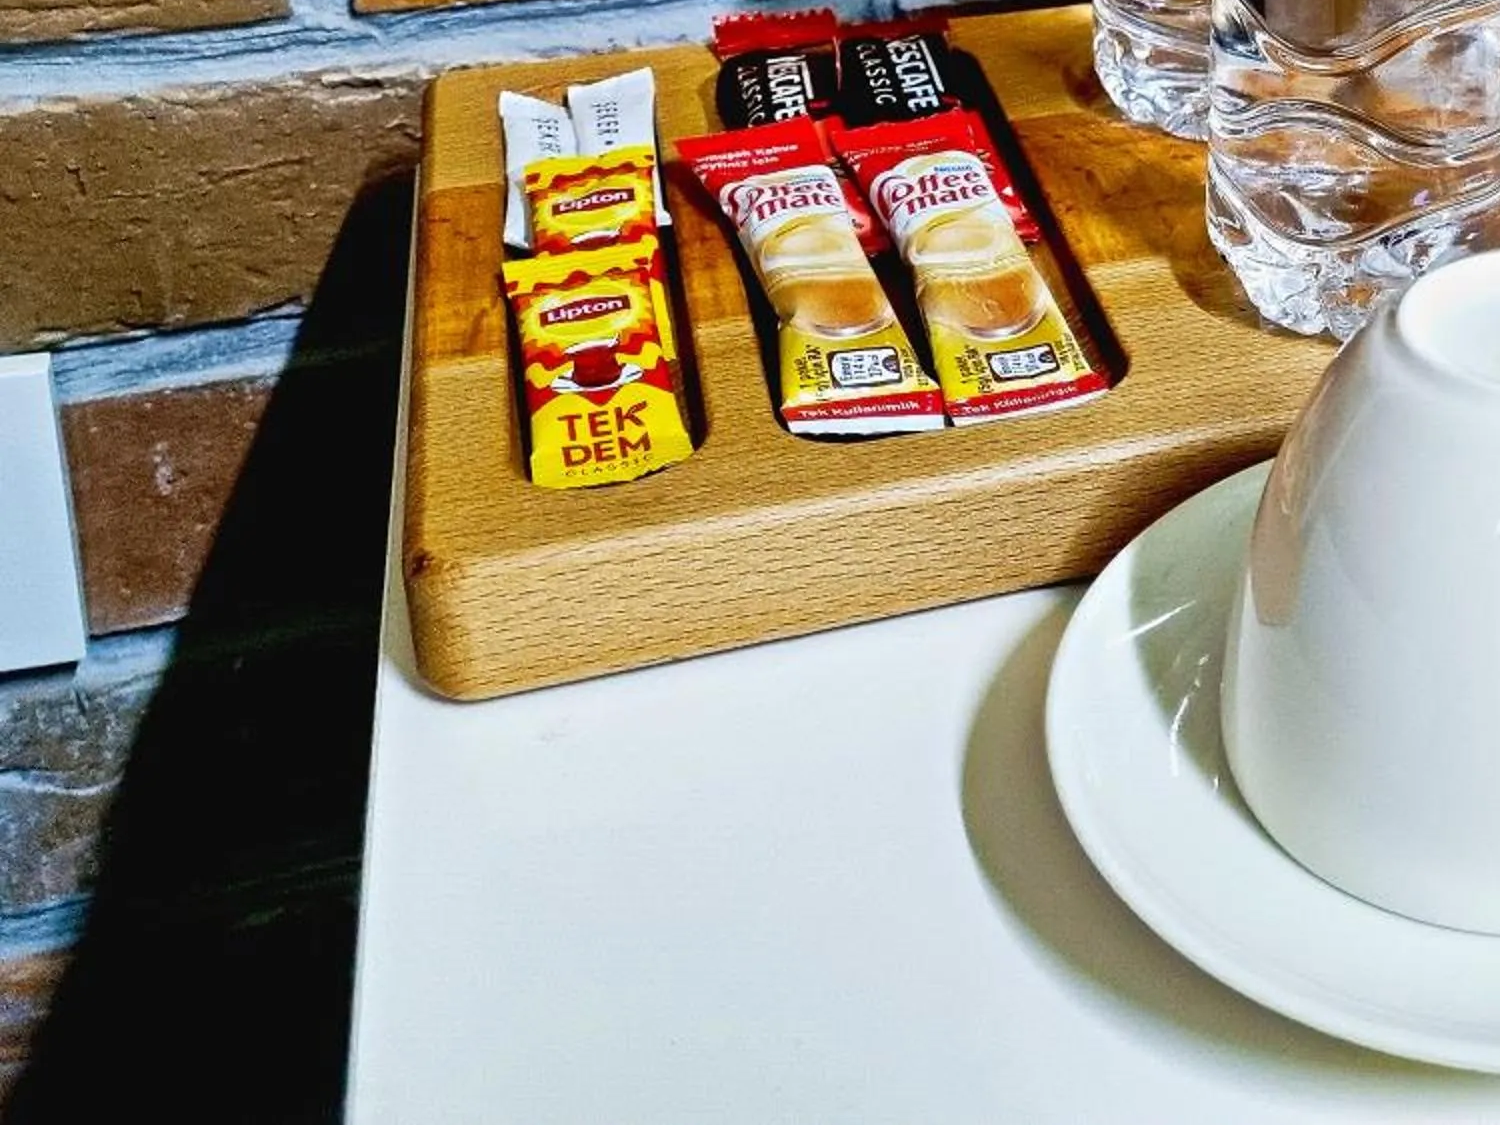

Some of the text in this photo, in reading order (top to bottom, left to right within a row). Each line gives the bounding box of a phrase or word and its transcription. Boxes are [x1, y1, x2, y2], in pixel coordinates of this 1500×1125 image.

[558, 190, 630, 213] Lipton
[755, 192, 841, 221] mate
[877, 172, 982, 220] Coffee
[905, 183, 990, 216] mate
[547, 299, 624, 322] Lipton
[558, 400, 648, 442] TEK
[561, 431, 651, 468] DEM
[564, 453, 654, 477] CLASSIC
